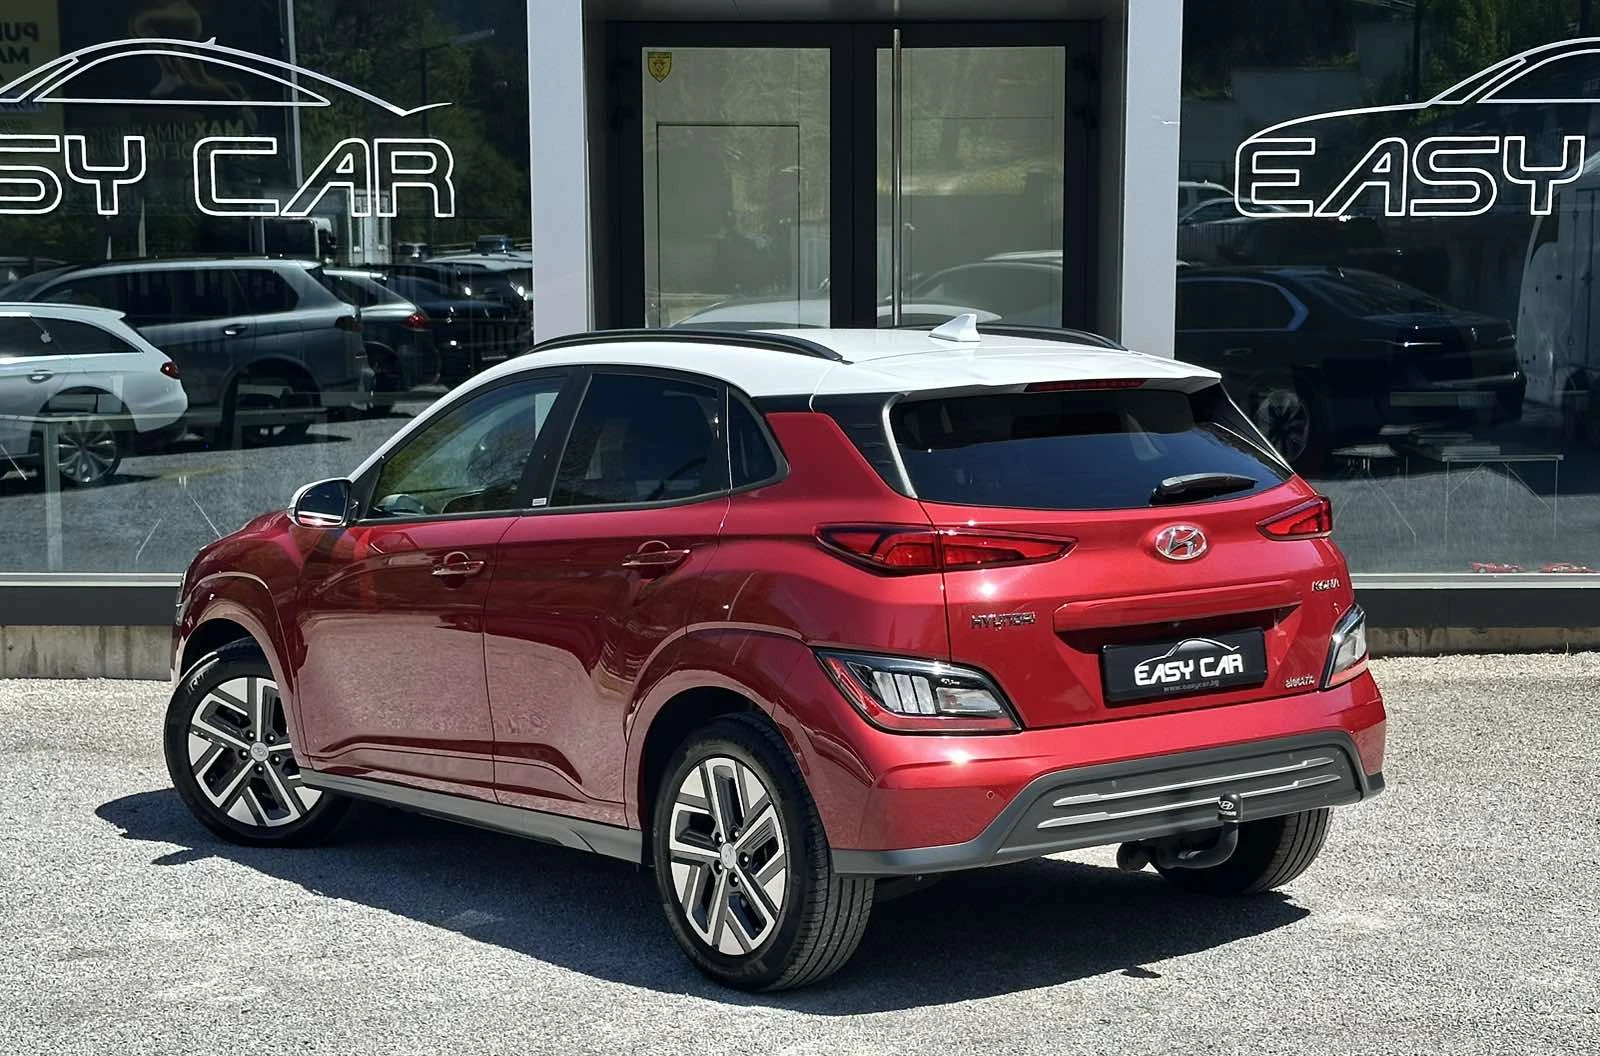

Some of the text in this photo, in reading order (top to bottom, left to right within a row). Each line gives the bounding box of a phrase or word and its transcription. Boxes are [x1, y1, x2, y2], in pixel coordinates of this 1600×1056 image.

[193, 137, 455, 217] CAR
[1234, 135, 1586, 217] EASY
[1134, 653, 1244, 686] EASY CAR
